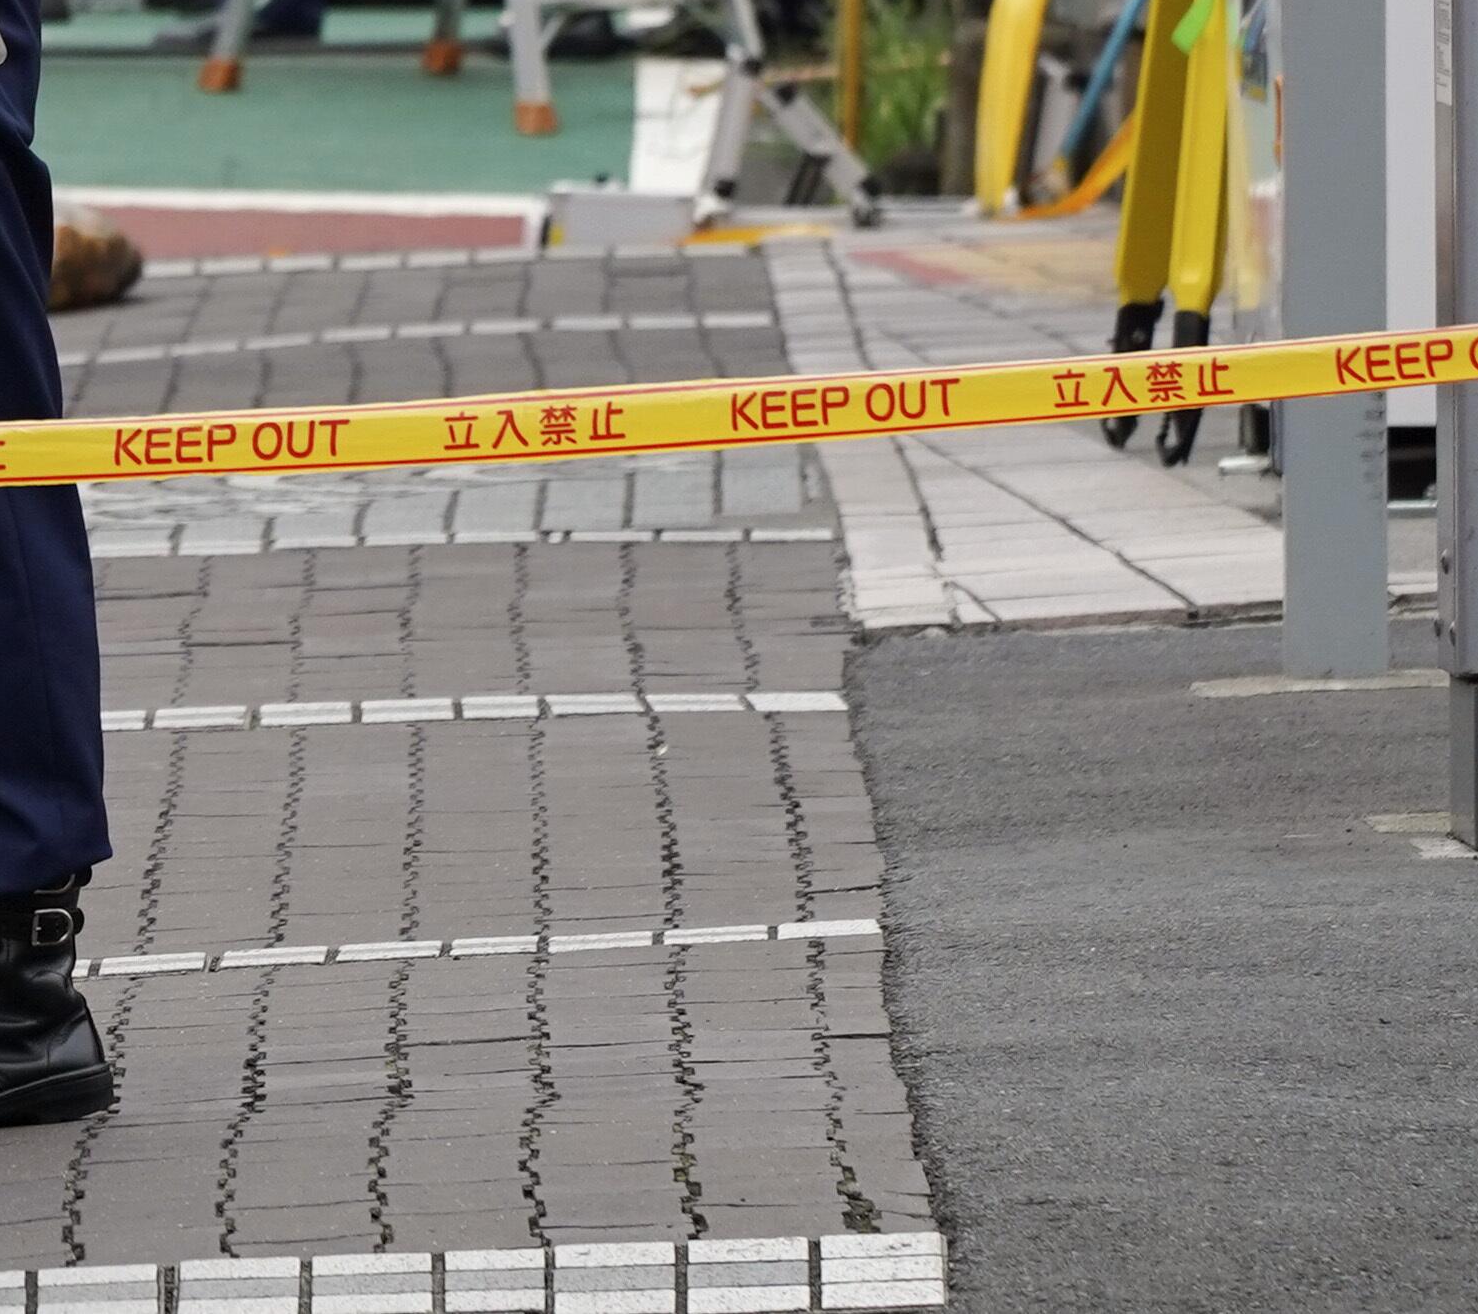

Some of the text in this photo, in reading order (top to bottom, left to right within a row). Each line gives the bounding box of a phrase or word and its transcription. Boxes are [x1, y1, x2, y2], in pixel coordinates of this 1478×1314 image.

[113, 423, 238, 466] KEEP
[251, 419, 350, 460] OUT
[443, 401, 627, 452] 立入禁止
[731, 384, 851, 431] KEEP
[864, 376, 961, 422] OUT
[1052, 356, 1236, 409] 立入禁止
[1335, 338, 1454, 385] KEEP
